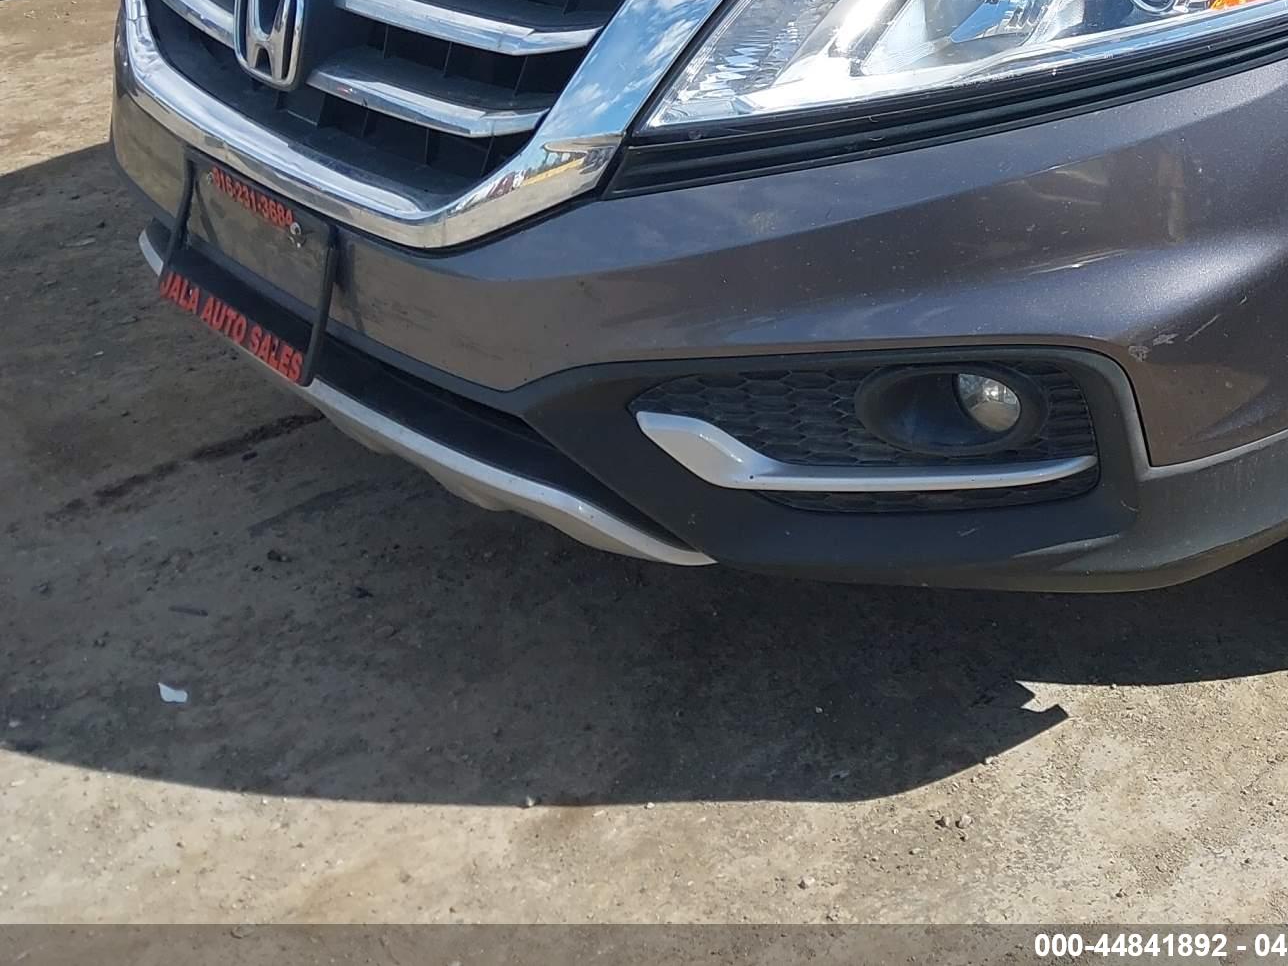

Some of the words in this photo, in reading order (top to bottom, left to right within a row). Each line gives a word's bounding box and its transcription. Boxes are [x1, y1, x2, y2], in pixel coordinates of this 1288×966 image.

[160, 272, 200, 315] JALA
[201, 295, 247, 346] AUTO
[249, 323, 304, 383] SALES
